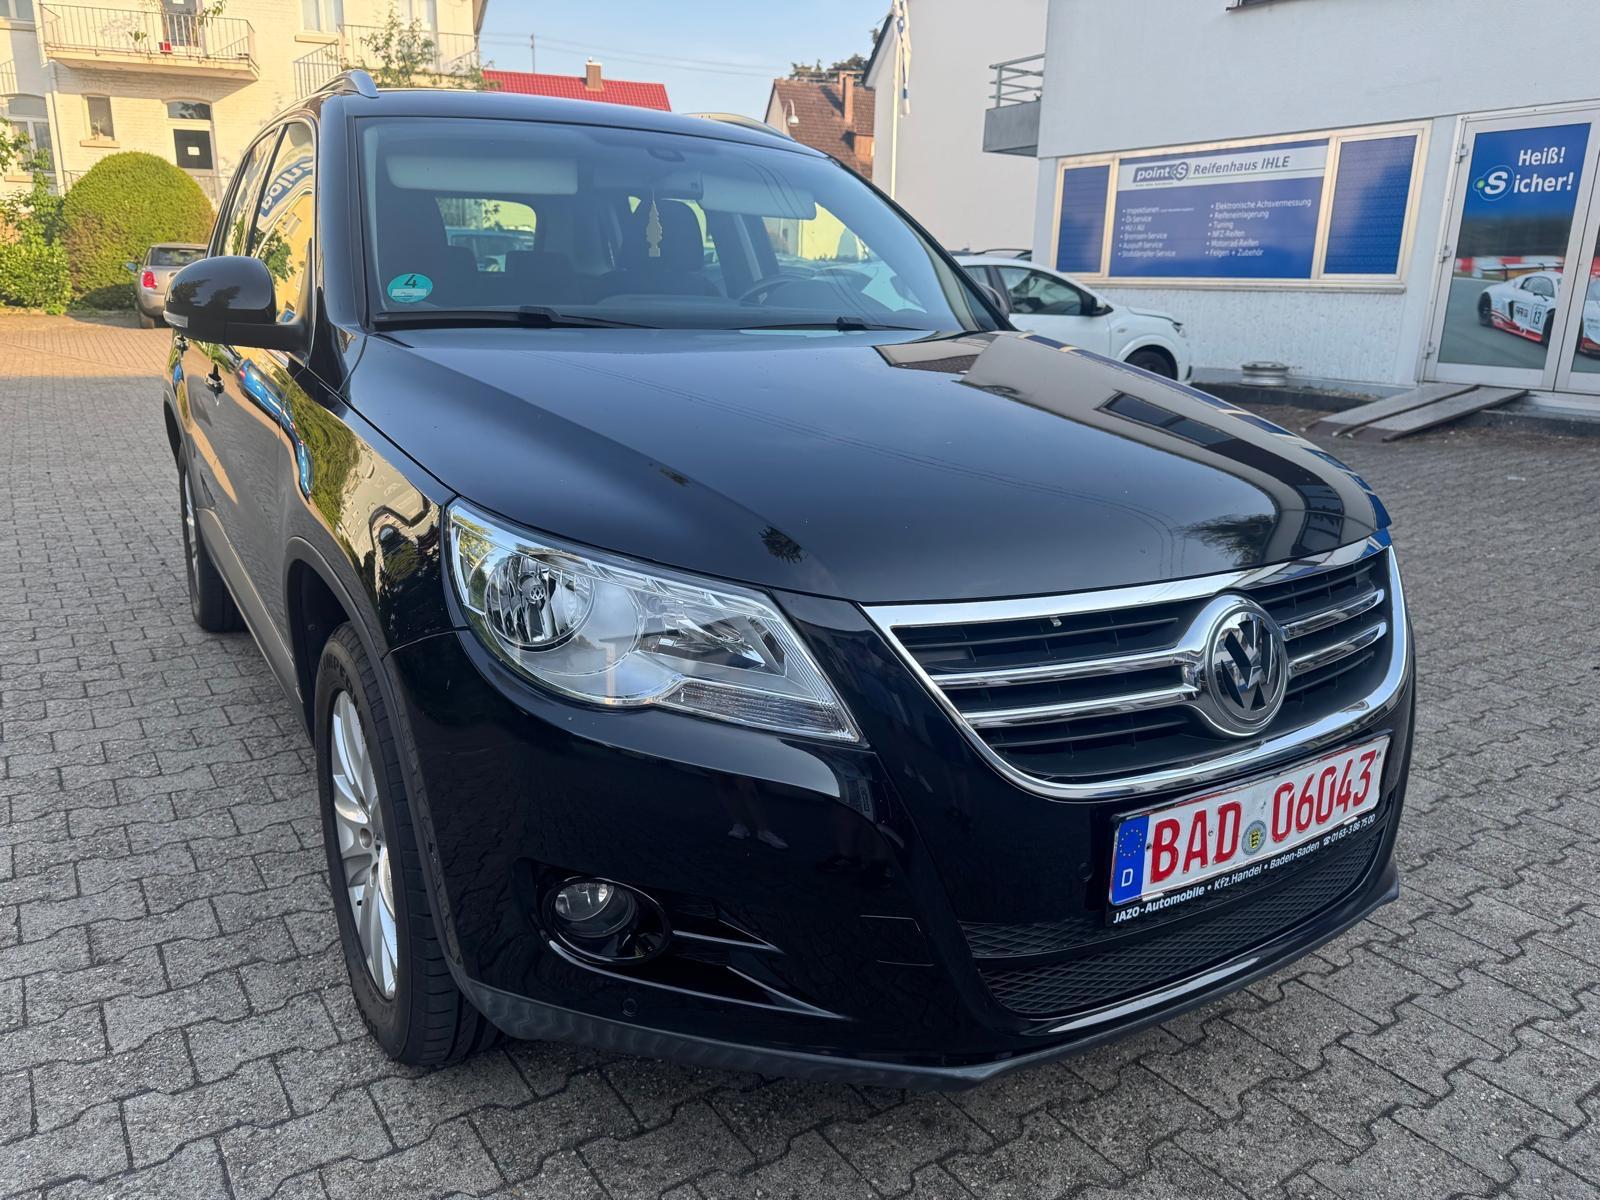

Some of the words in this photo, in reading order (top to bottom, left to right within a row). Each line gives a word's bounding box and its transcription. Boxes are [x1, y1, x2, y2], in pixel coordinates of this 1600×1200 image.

[1136, 167, 1170, 181] point
[1193, 160, 1258, 175] Reifenhaus
[1261, 155, 1291, 169] IHLE
[1518, 147, 1566, 167] Heiß!
[404, 274, 418, 288] 4
[1150, 800, 1243, 884] BAD
[1271, 749, 1377, 844] 06043
[1112, 885, 1205, 924] JAZO-Automobile
[1269, 840, 1320, 870] Baden-Baden
[1121, 868, 1134, 887] D
